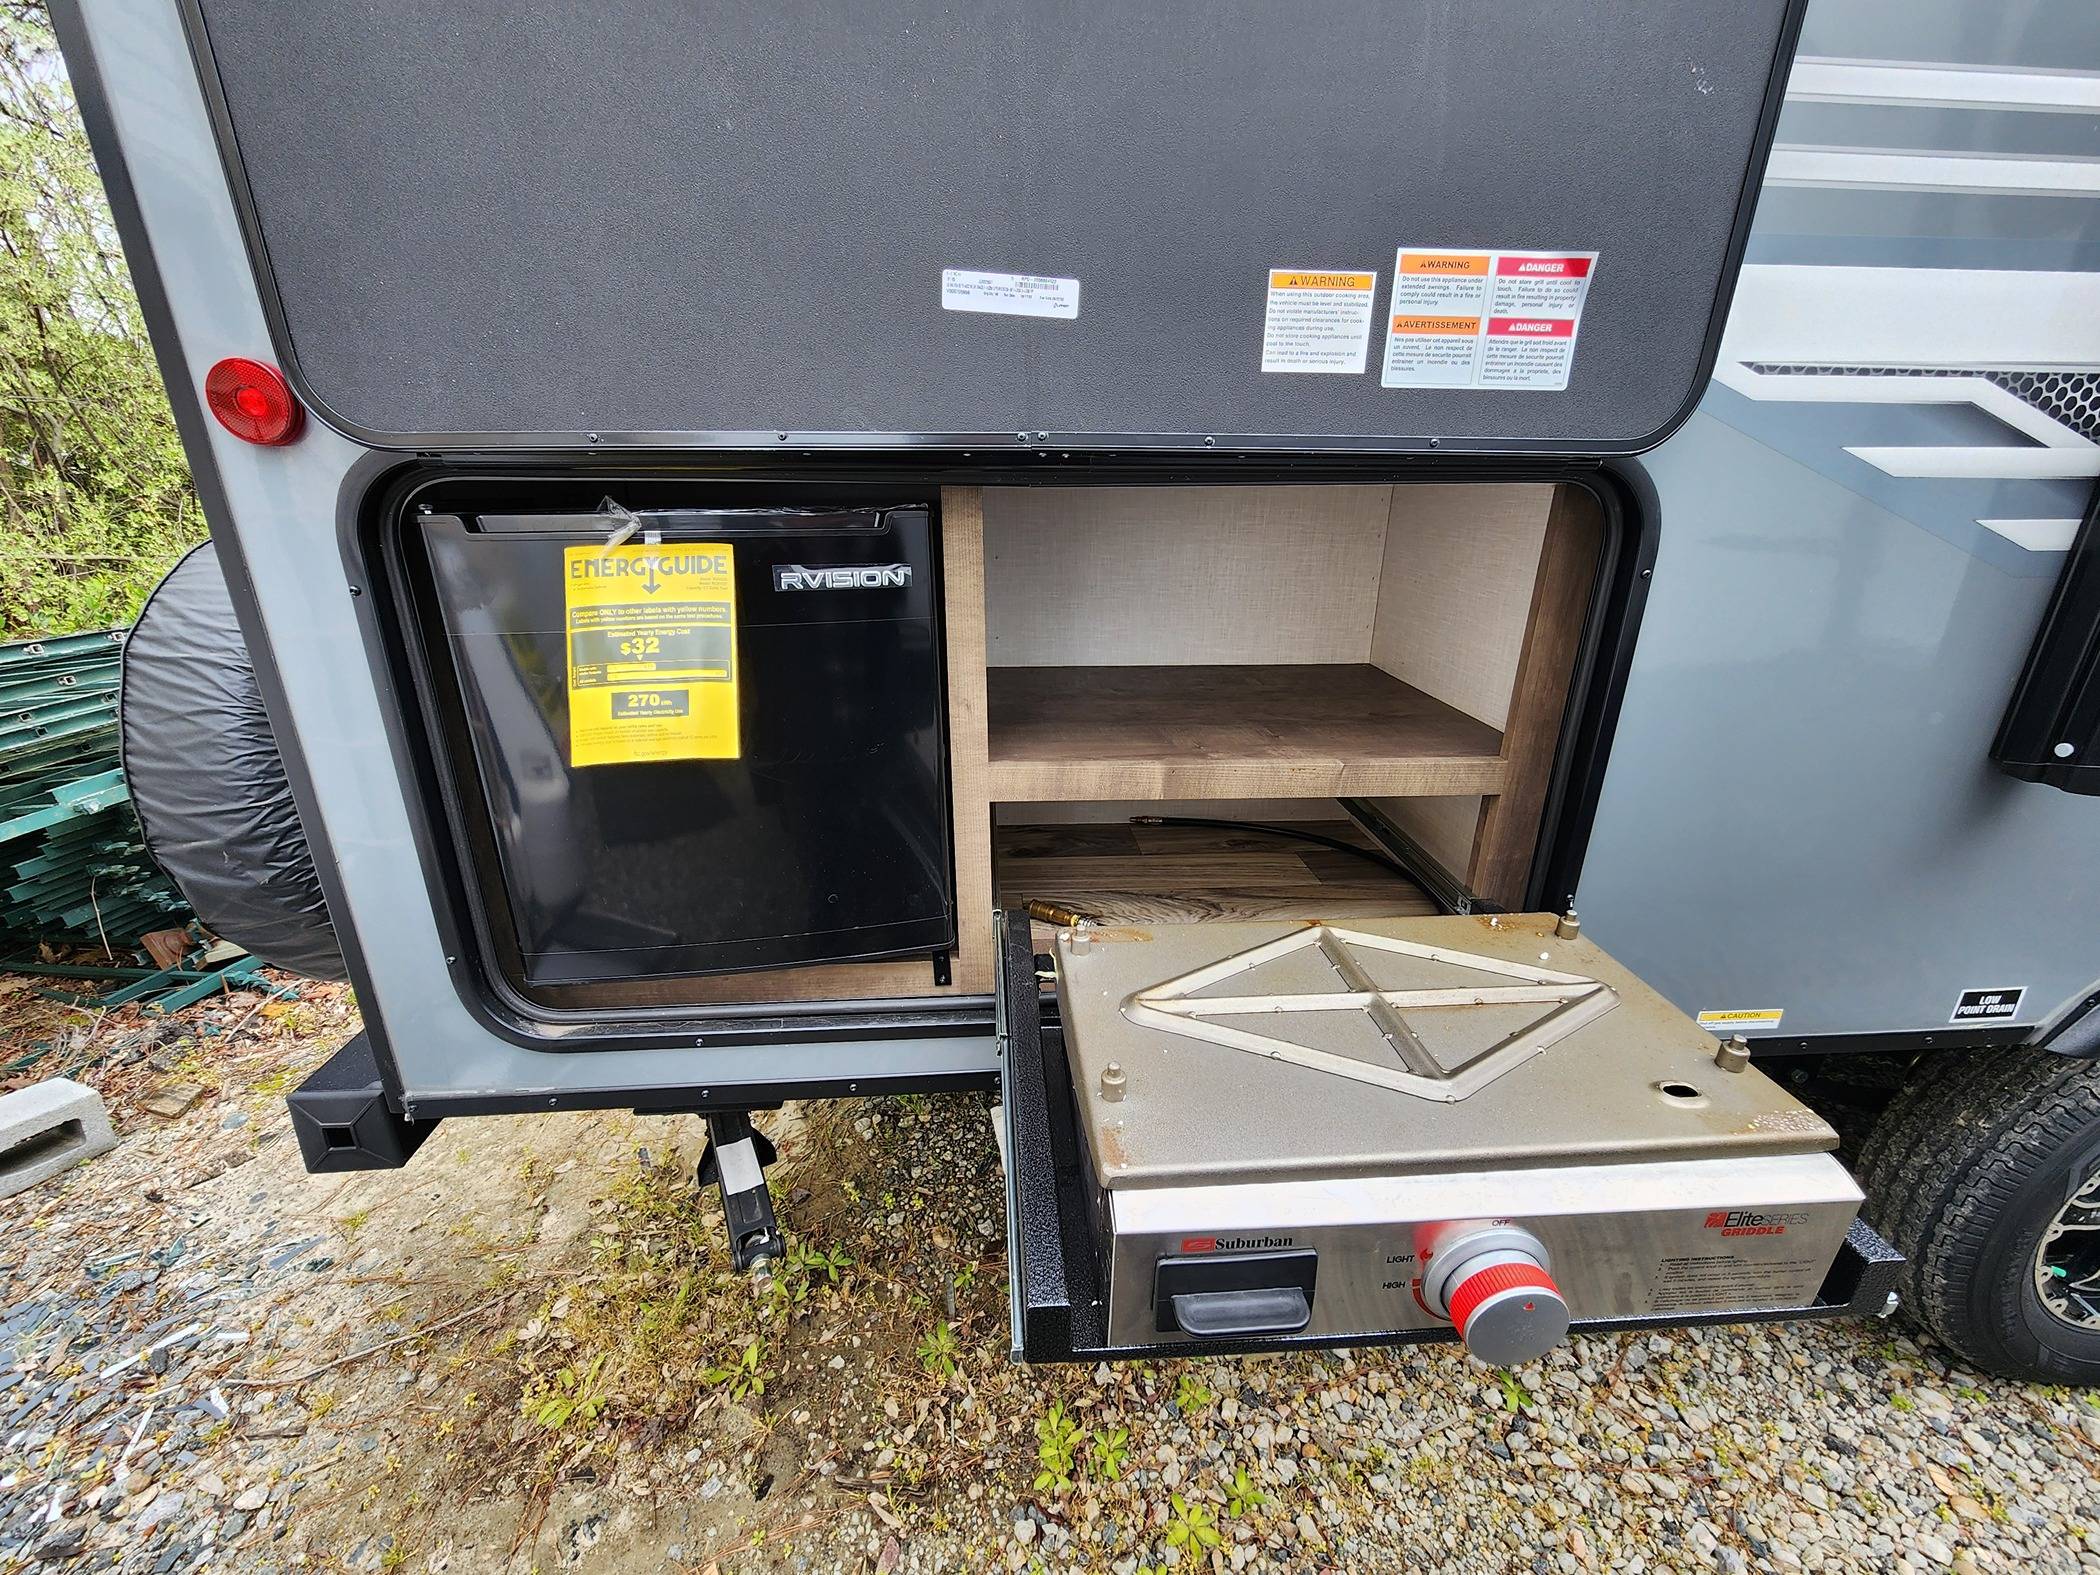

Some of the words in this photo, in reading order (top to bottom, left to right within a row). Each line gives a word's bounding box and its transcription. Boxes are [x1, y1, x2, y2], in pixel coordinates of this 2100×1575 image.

[1427, 261, 1470, 269] WARNING
[1526, 263, 1564, 272] DANGER
[1300, 276, 1355, 287] WARNING
[1403, 321, 1476, 329] AVERTISSEMENT
[1516, 324, 1552, 332] DANGER
[570, 555, 728, 579] ENERGYGUIDE
[780, 570, 905, 590] RVISION
[599, 609, 616, 617] ONLY
[626, 607, 642, 615] other
[643, 606, 661, 614] labels
[678, 606, 697, 614] yellow
[607, 629, 636, 638] Estimated
[637, 629, 654, 637] Yearly
[620, 637, 660, 655] $32
[627, 693, 660, 708] 270
[1979, 995, 2002, 1005] LOW
[1957, 1005, 1987, 1015] POINT
[1986, 1003, 2016, 1014] DRAIN
[1721, 1226, 1786, 1237] GRIDDLE
[1215, 1236, 1293, 1250] Suburban
[1386, 1254, 1416, 1264] LIGHT
[1382, 1281, 1406, 1290] HIGH
